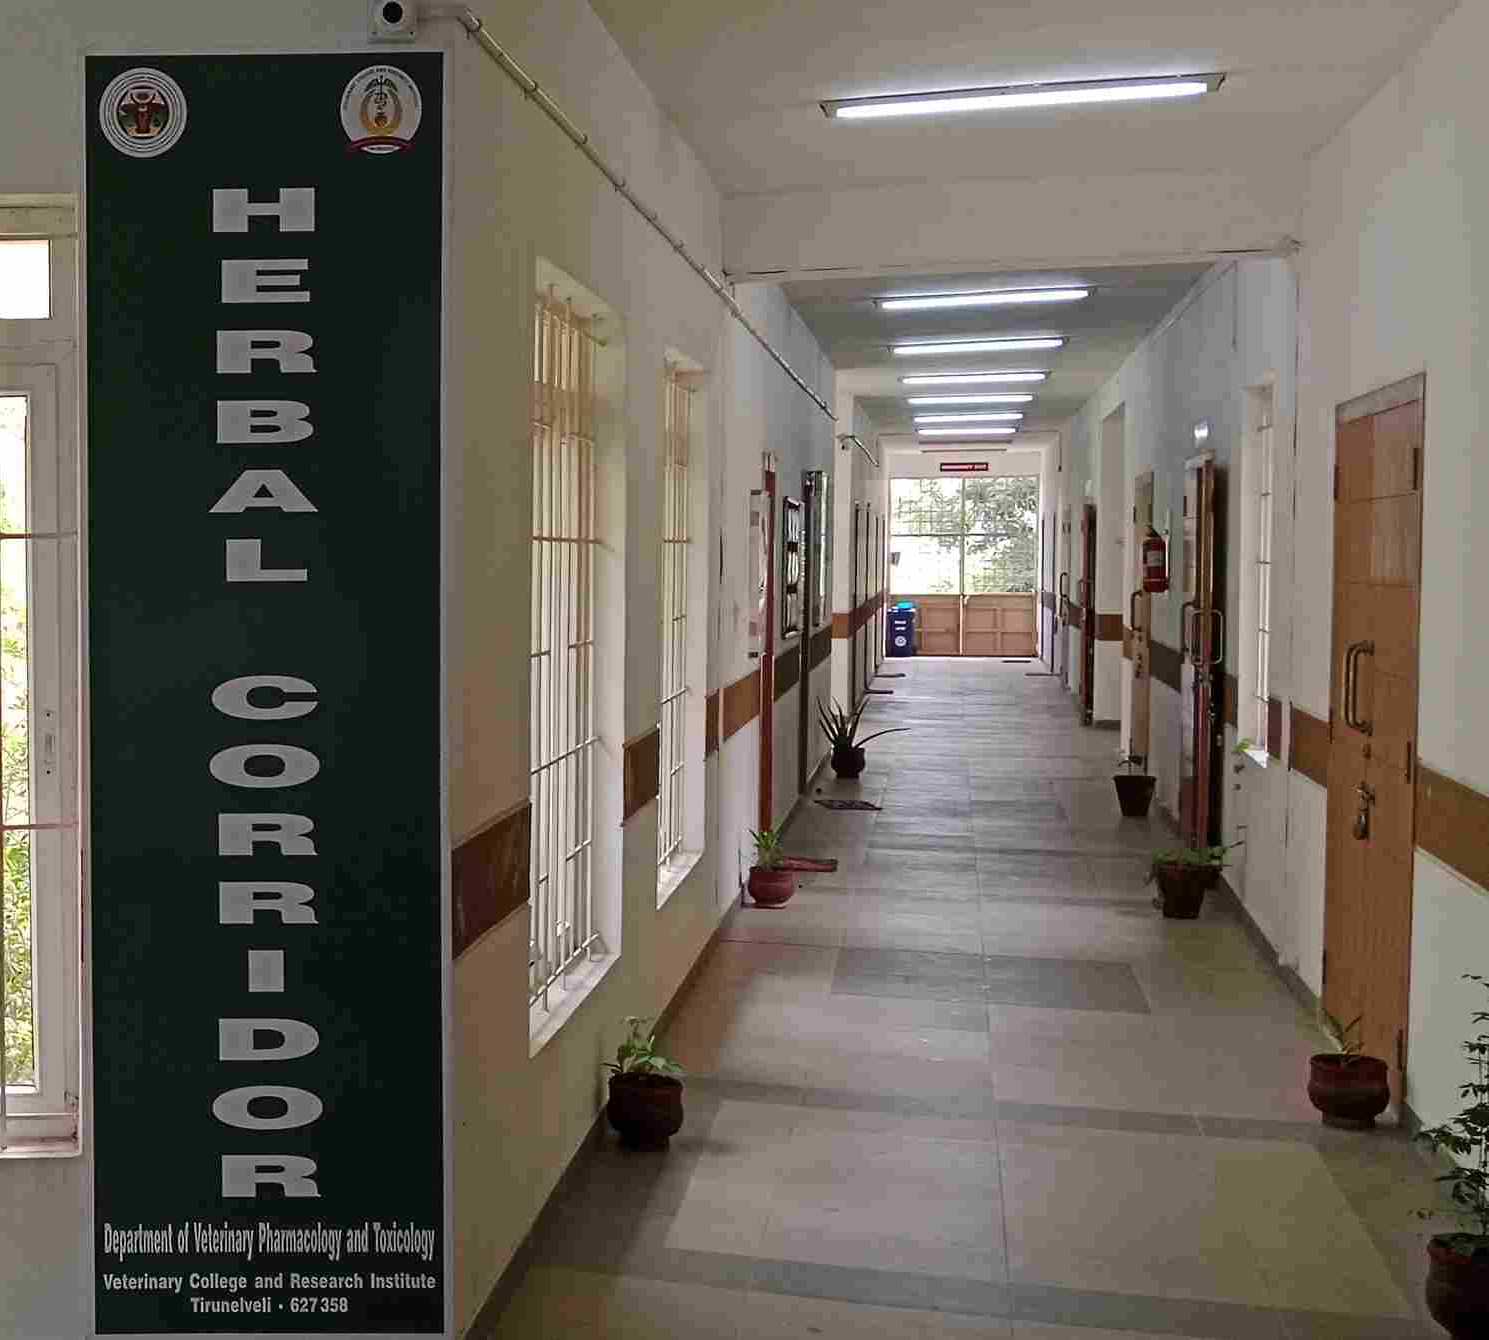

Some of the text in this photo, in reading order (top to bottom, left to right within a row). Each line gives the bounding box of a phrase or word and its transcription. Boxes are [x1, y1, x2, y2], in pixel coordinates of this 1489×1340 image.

[208, 187, 323, 1198] HERBAL CORRIDOR
[103, 1220, 435, 1263] Department of Veterinary Pharmacology and Toxicology
[102, 1272, 436, 1294] Veterinary College and Research Institute
[190, 1296, 272, 1313] Tirunelveli
